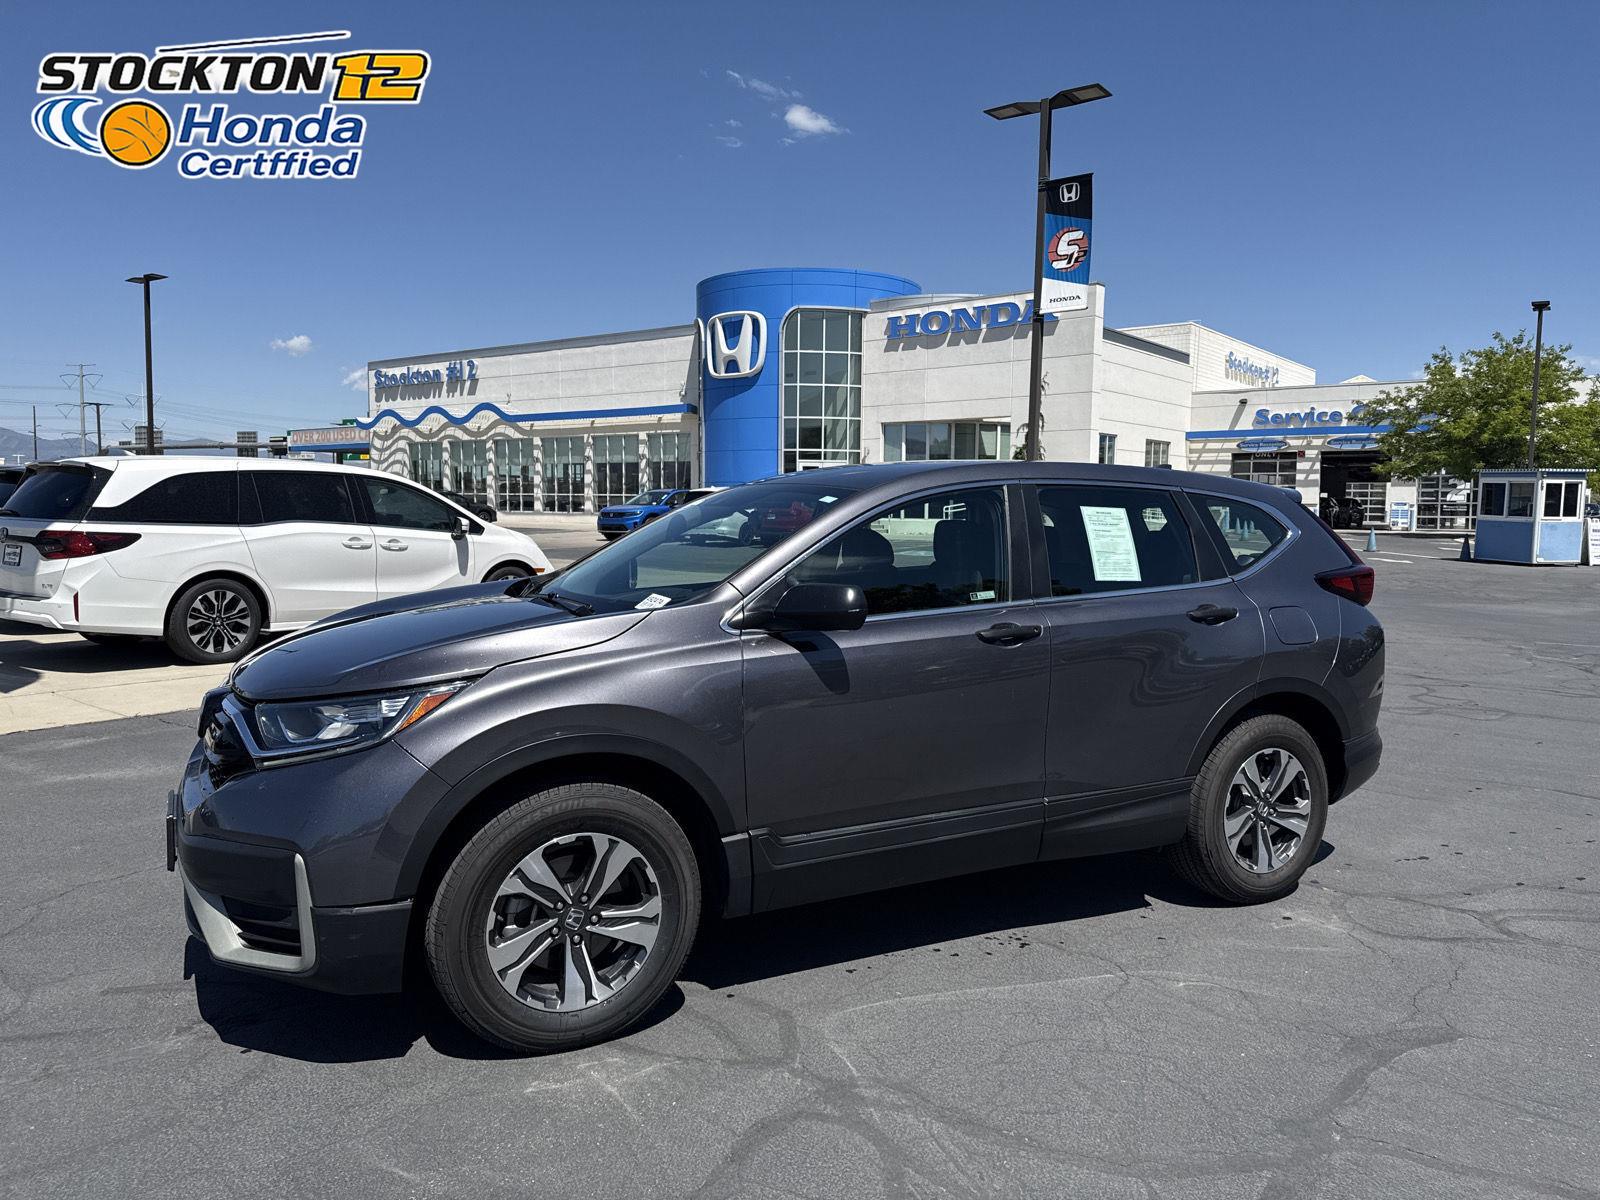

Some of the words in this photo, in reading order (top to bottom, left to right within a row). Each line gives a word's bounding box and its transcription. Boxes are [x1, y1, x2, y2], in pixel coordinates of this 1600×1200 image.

[1049, 294, 1082, 304] HONDA
[373, 366, 443, 389] Stockton
[445, 359, 478, 384] #12
[1254, 406, 1344, 426] Service
[292, 430, 314, 444] OVER
[315, 430, 331, 443] 200
[334, 428, 356, 442] USED
